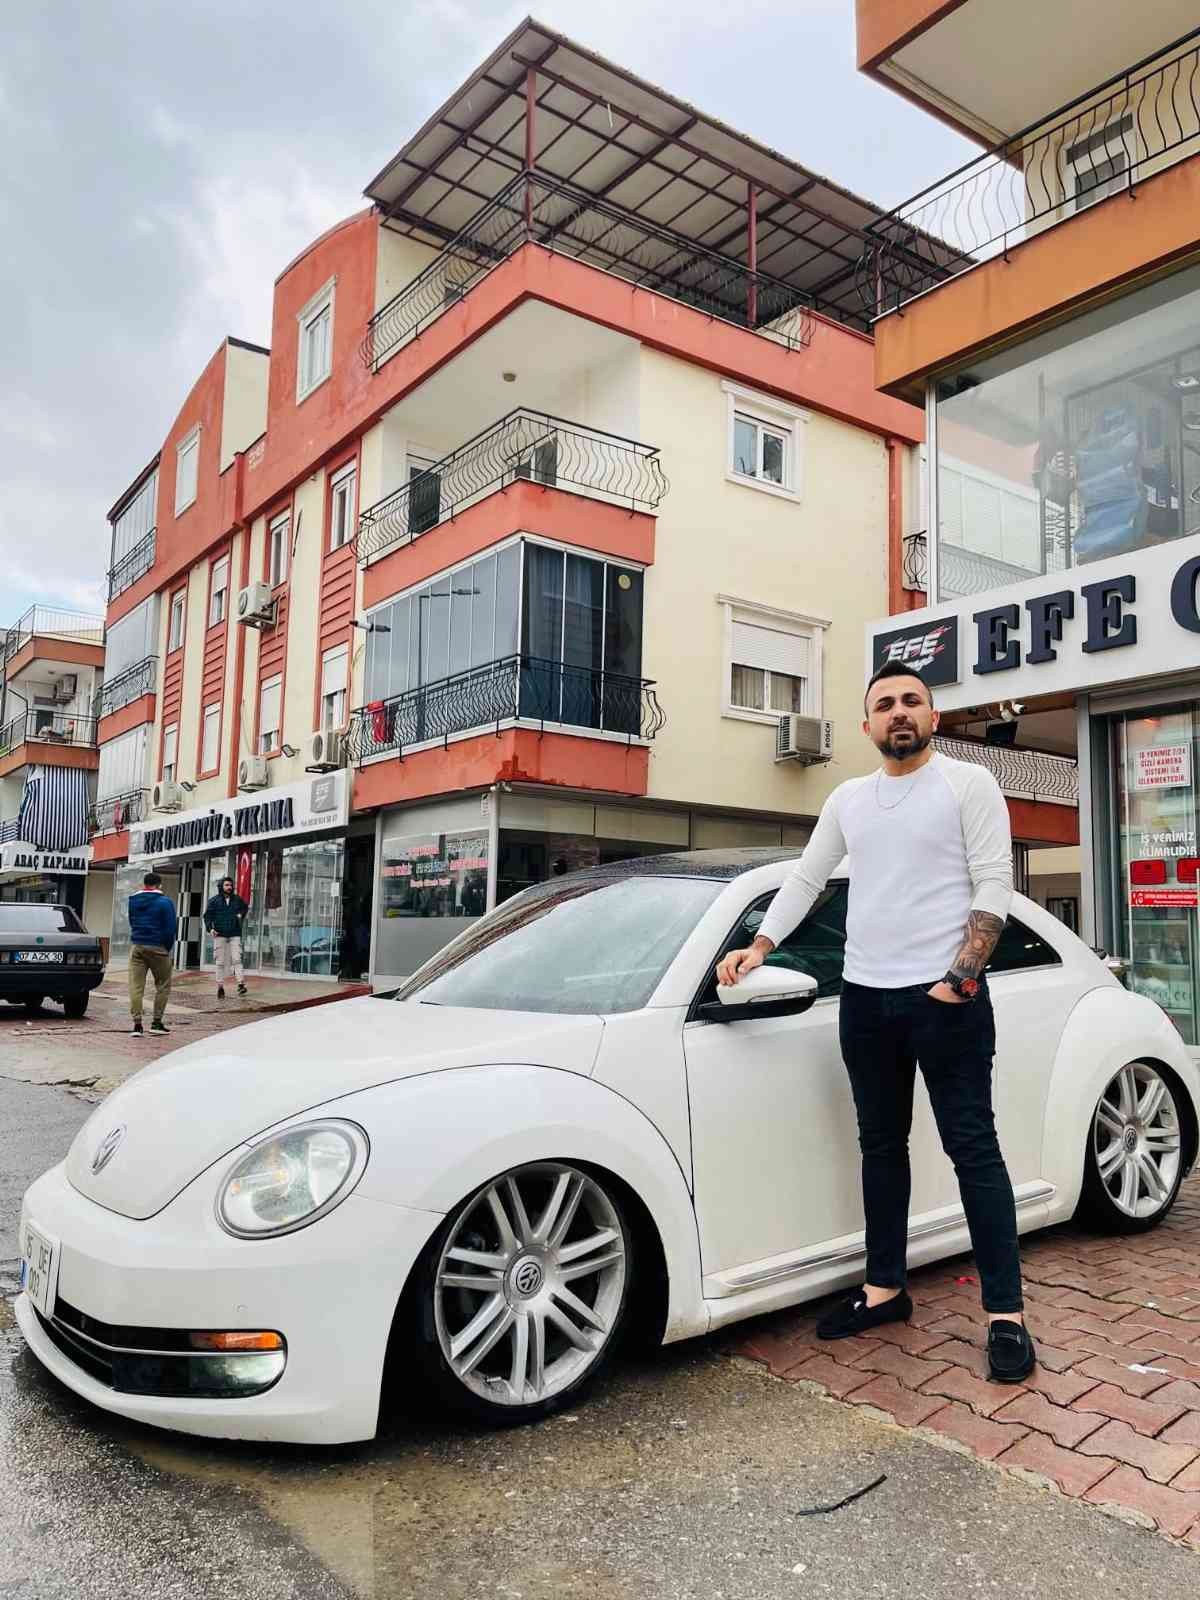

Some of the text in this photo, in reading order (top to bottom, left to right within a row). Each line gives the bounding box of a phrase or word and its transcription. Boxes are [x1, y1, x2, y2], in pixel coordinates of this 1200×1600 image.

[973, 575, 1137, 674] EFE
[887, 628, 944, 662] EFE
[824, 722, 832, 748] BOSCH
[164, 809, 223, 850] OTOMOTİV
[223, 816, 233, 839] &
[233, 797, 294, 836] YIKAMA
[14, 854, 86, 870] ARAÇ KAPLAMA
